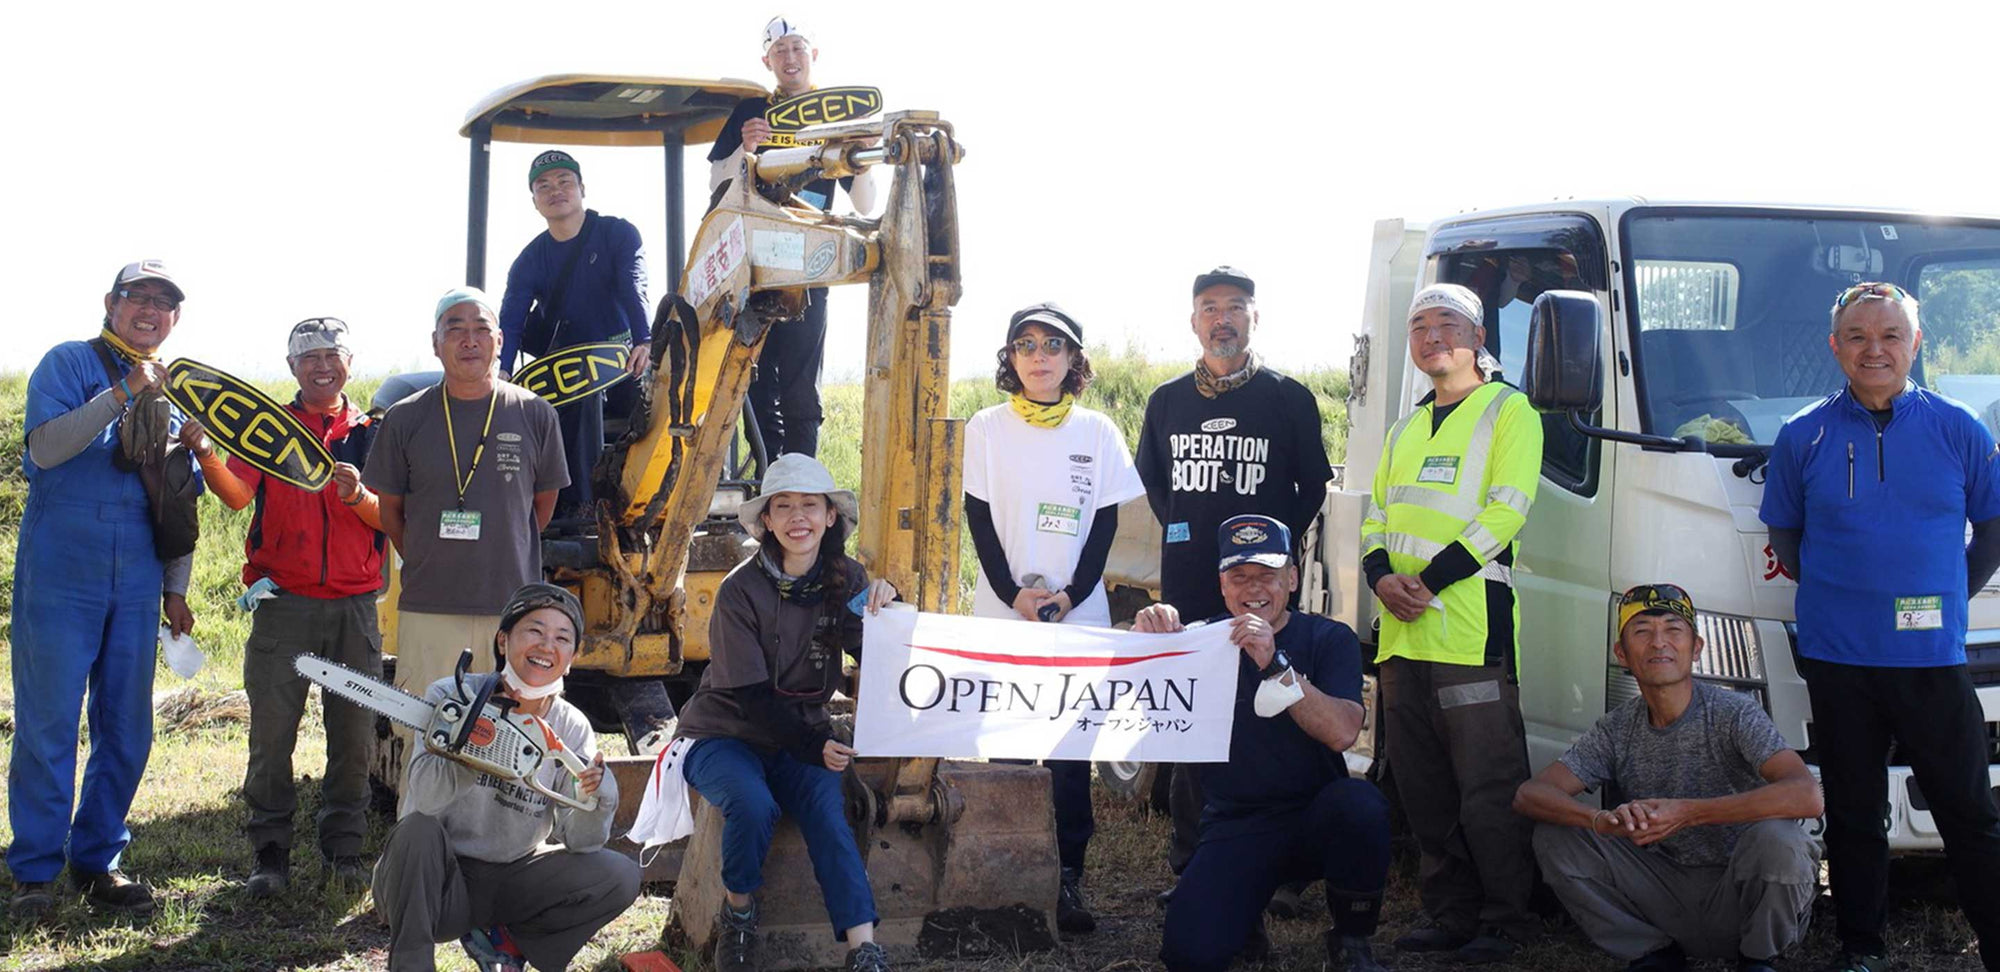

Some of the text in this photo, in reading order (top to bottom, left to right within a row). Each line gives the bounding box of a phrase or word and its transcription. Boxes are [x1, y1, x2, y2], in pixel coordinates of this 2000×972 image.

[770, 93, 876, 127] KEEN
[780, 135, 792, 145] IS
[520, 350, 627, 400] EEN
[172, 369, 326, 482] KEEN
[1202, 419, 1236, 431] KEEN
[1169, 433, 1269, 463] OPERATION
[1171, 459, 1266, 495] BOOT UP
[344, 679, 375, 698] STIHL
[899, 664, 1199, 721] OPEN JAPAN
[1076, 716, 1194, 733] オープンジャパン
